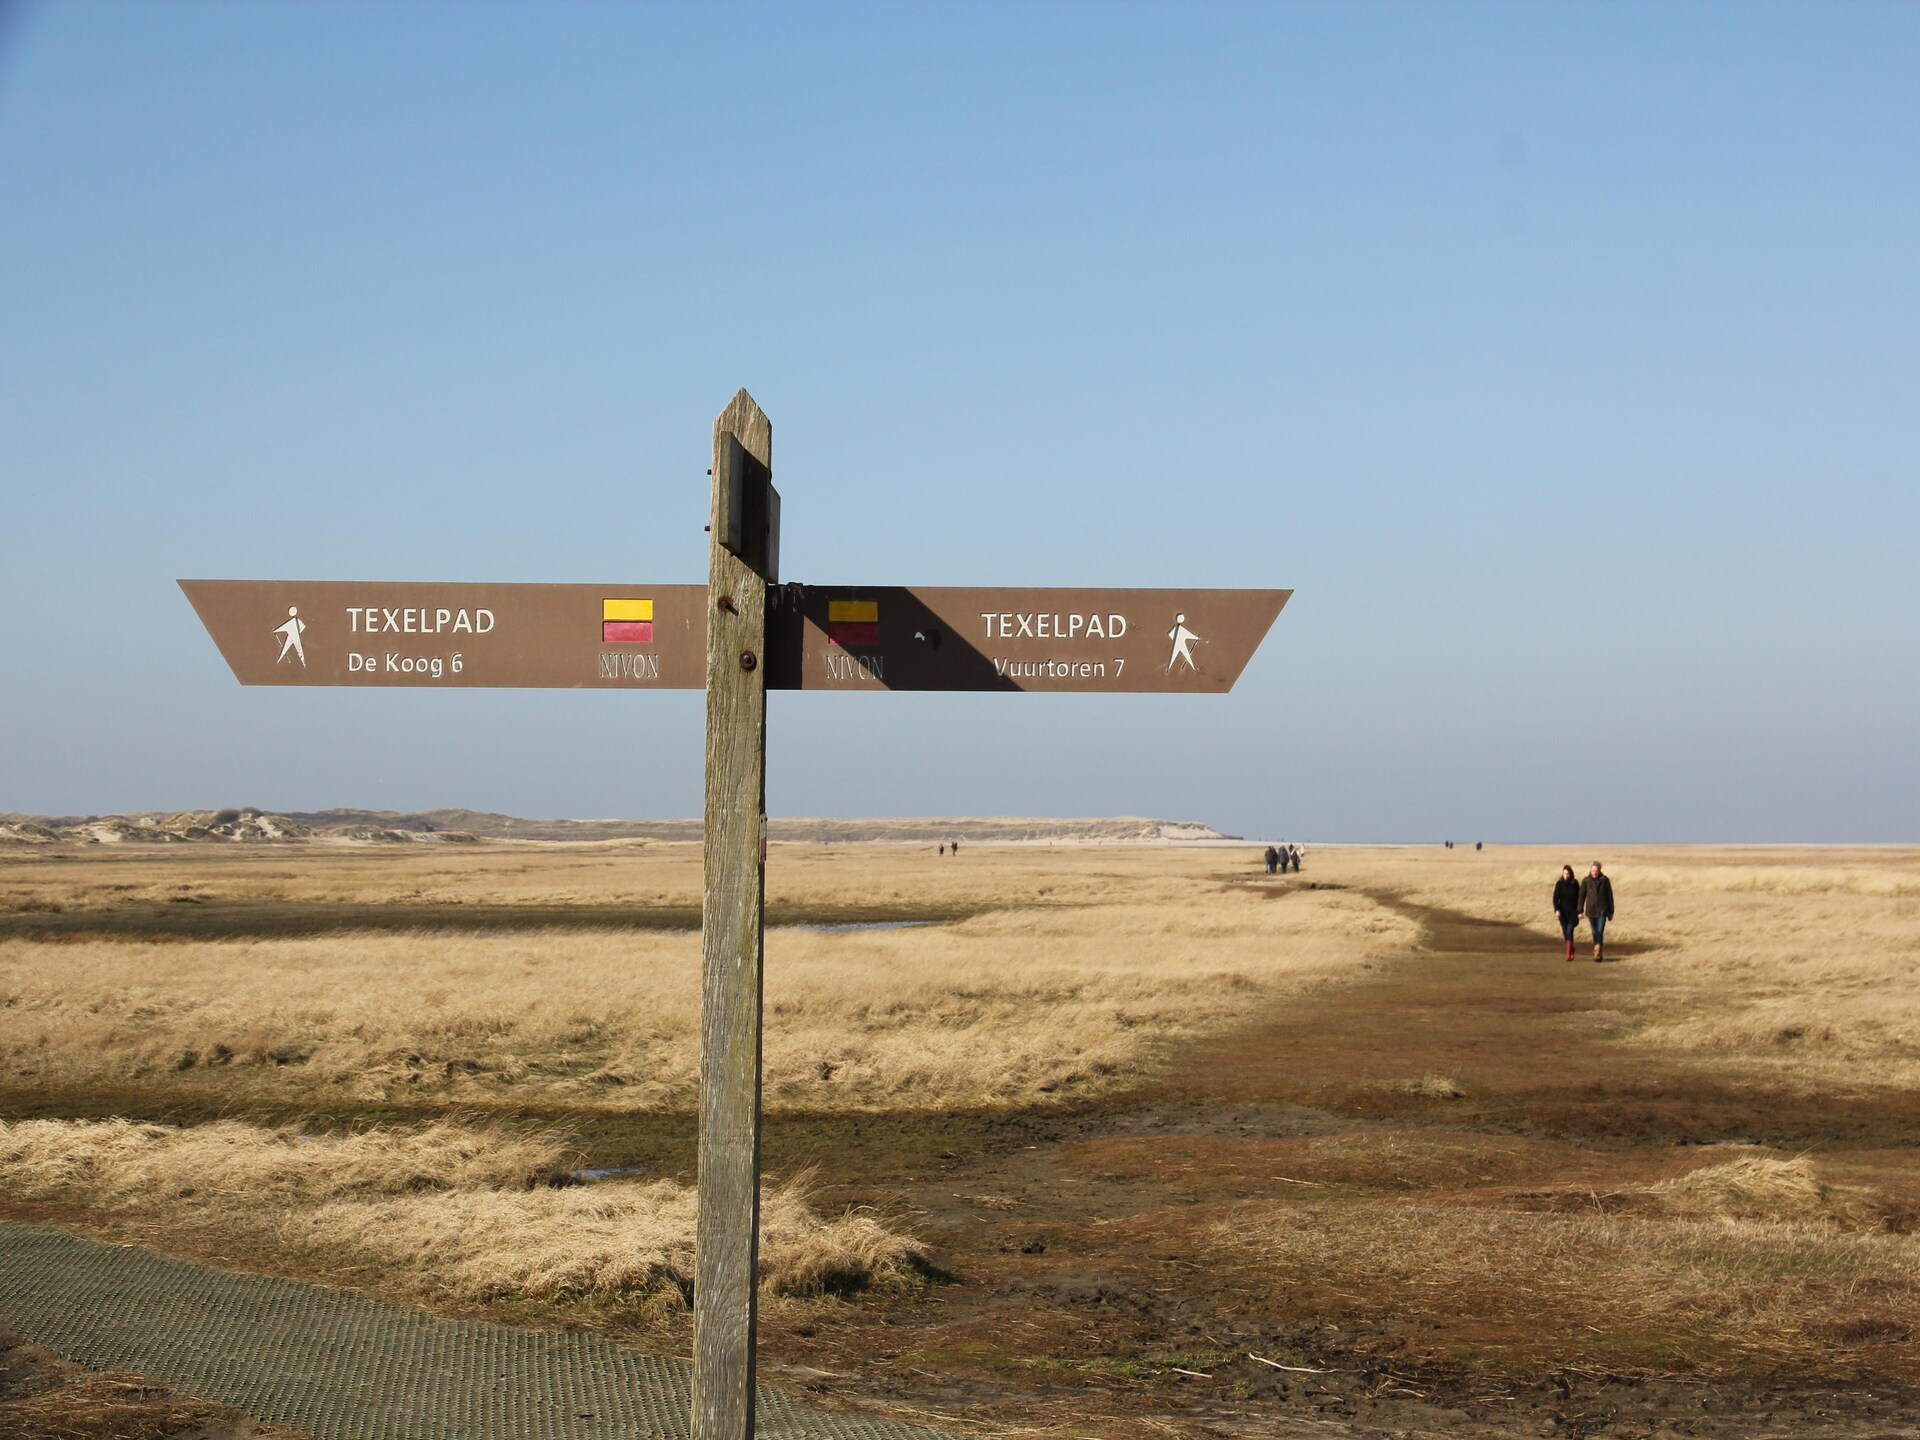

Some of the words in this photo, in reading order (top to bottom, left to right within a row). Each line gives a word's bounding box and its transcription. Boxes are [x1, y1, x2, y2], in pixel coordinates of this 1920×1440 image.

[346, 607, 495, 633] TEXELPAD
[980, 613, 1127, 638] TEXELPAD
[348, 652, 377, 672] De
[385, 652, 443, 678] Koog
[451, 652, 463, 673] 6
[600, 653, 658, 678] NIVON
[825, 655, 884, 680] NIVON
[993, 657, 1105, 677] Vuurtoren
[1113, 658, 1125, 677] 7
